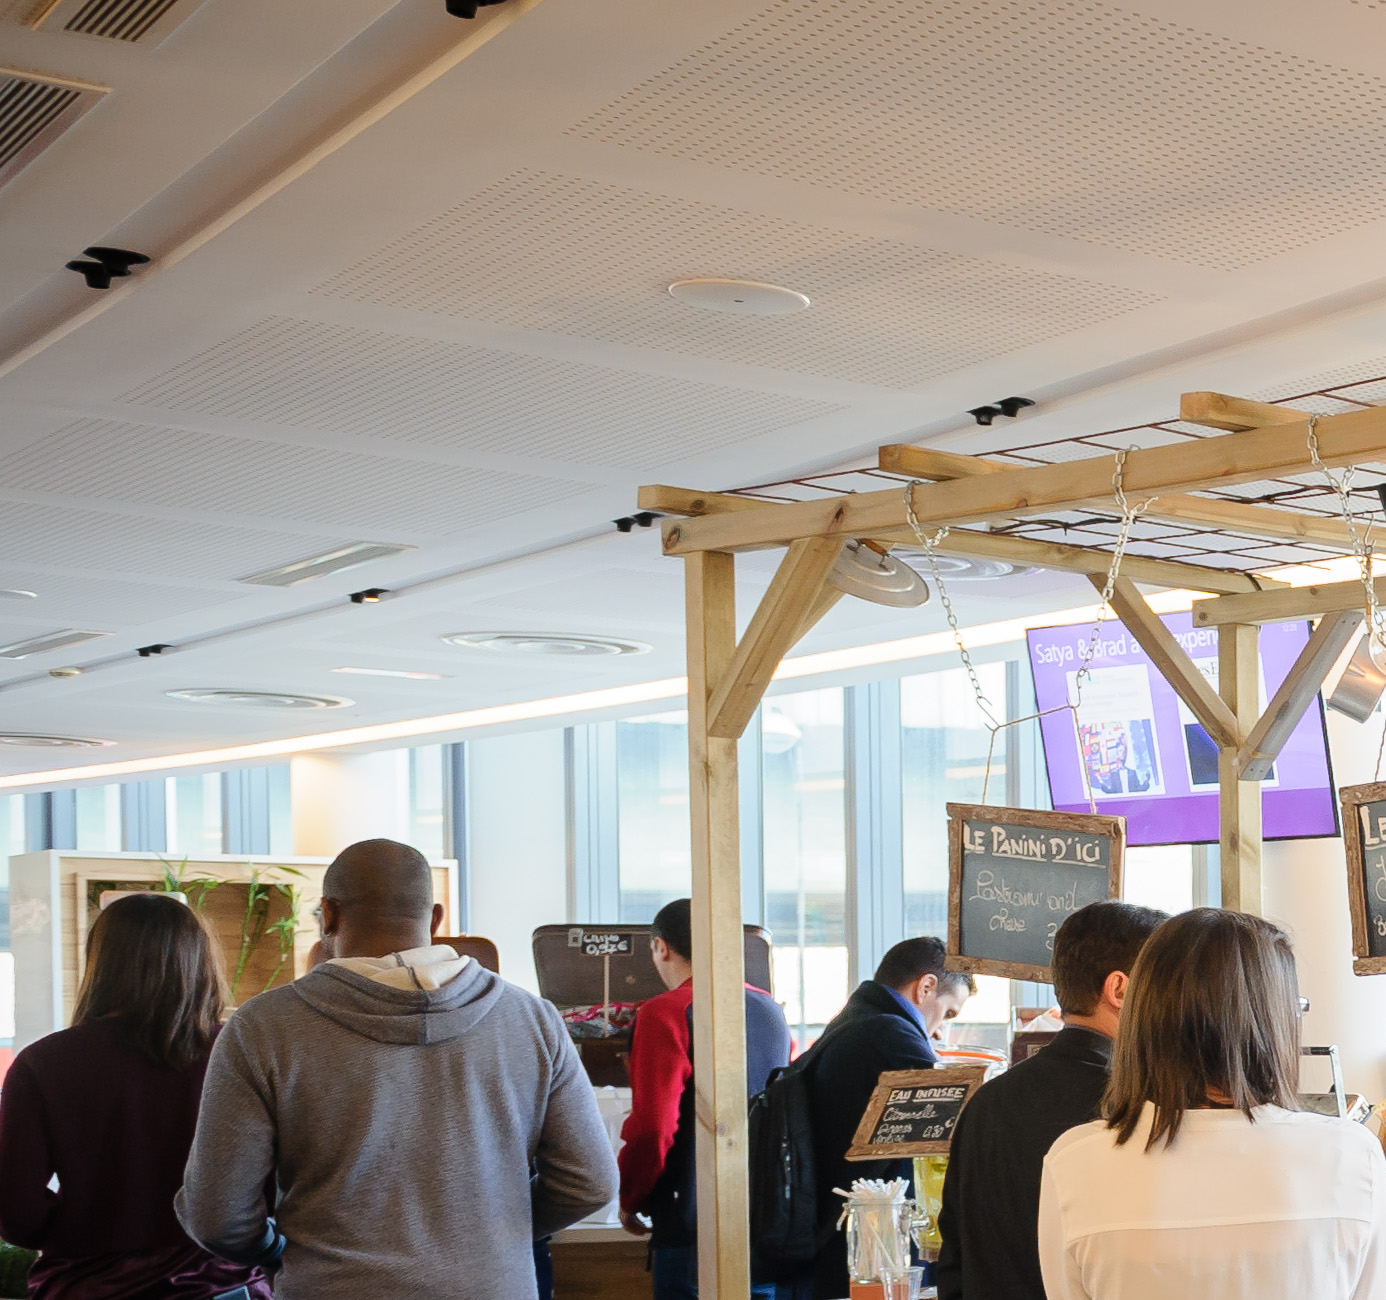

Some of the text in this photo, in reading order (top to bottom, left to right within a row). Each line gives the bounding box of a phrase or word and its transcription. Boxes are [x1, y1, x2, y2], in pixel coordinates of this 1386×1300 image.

[1035, 643, 1075, 667] Satya
[1077, 638, 1091, 659] &
[1093, 634, 1127, 658] Brad
[963, 822, 986, 851] LE
[888, 1089, 912, 1102] EAU
